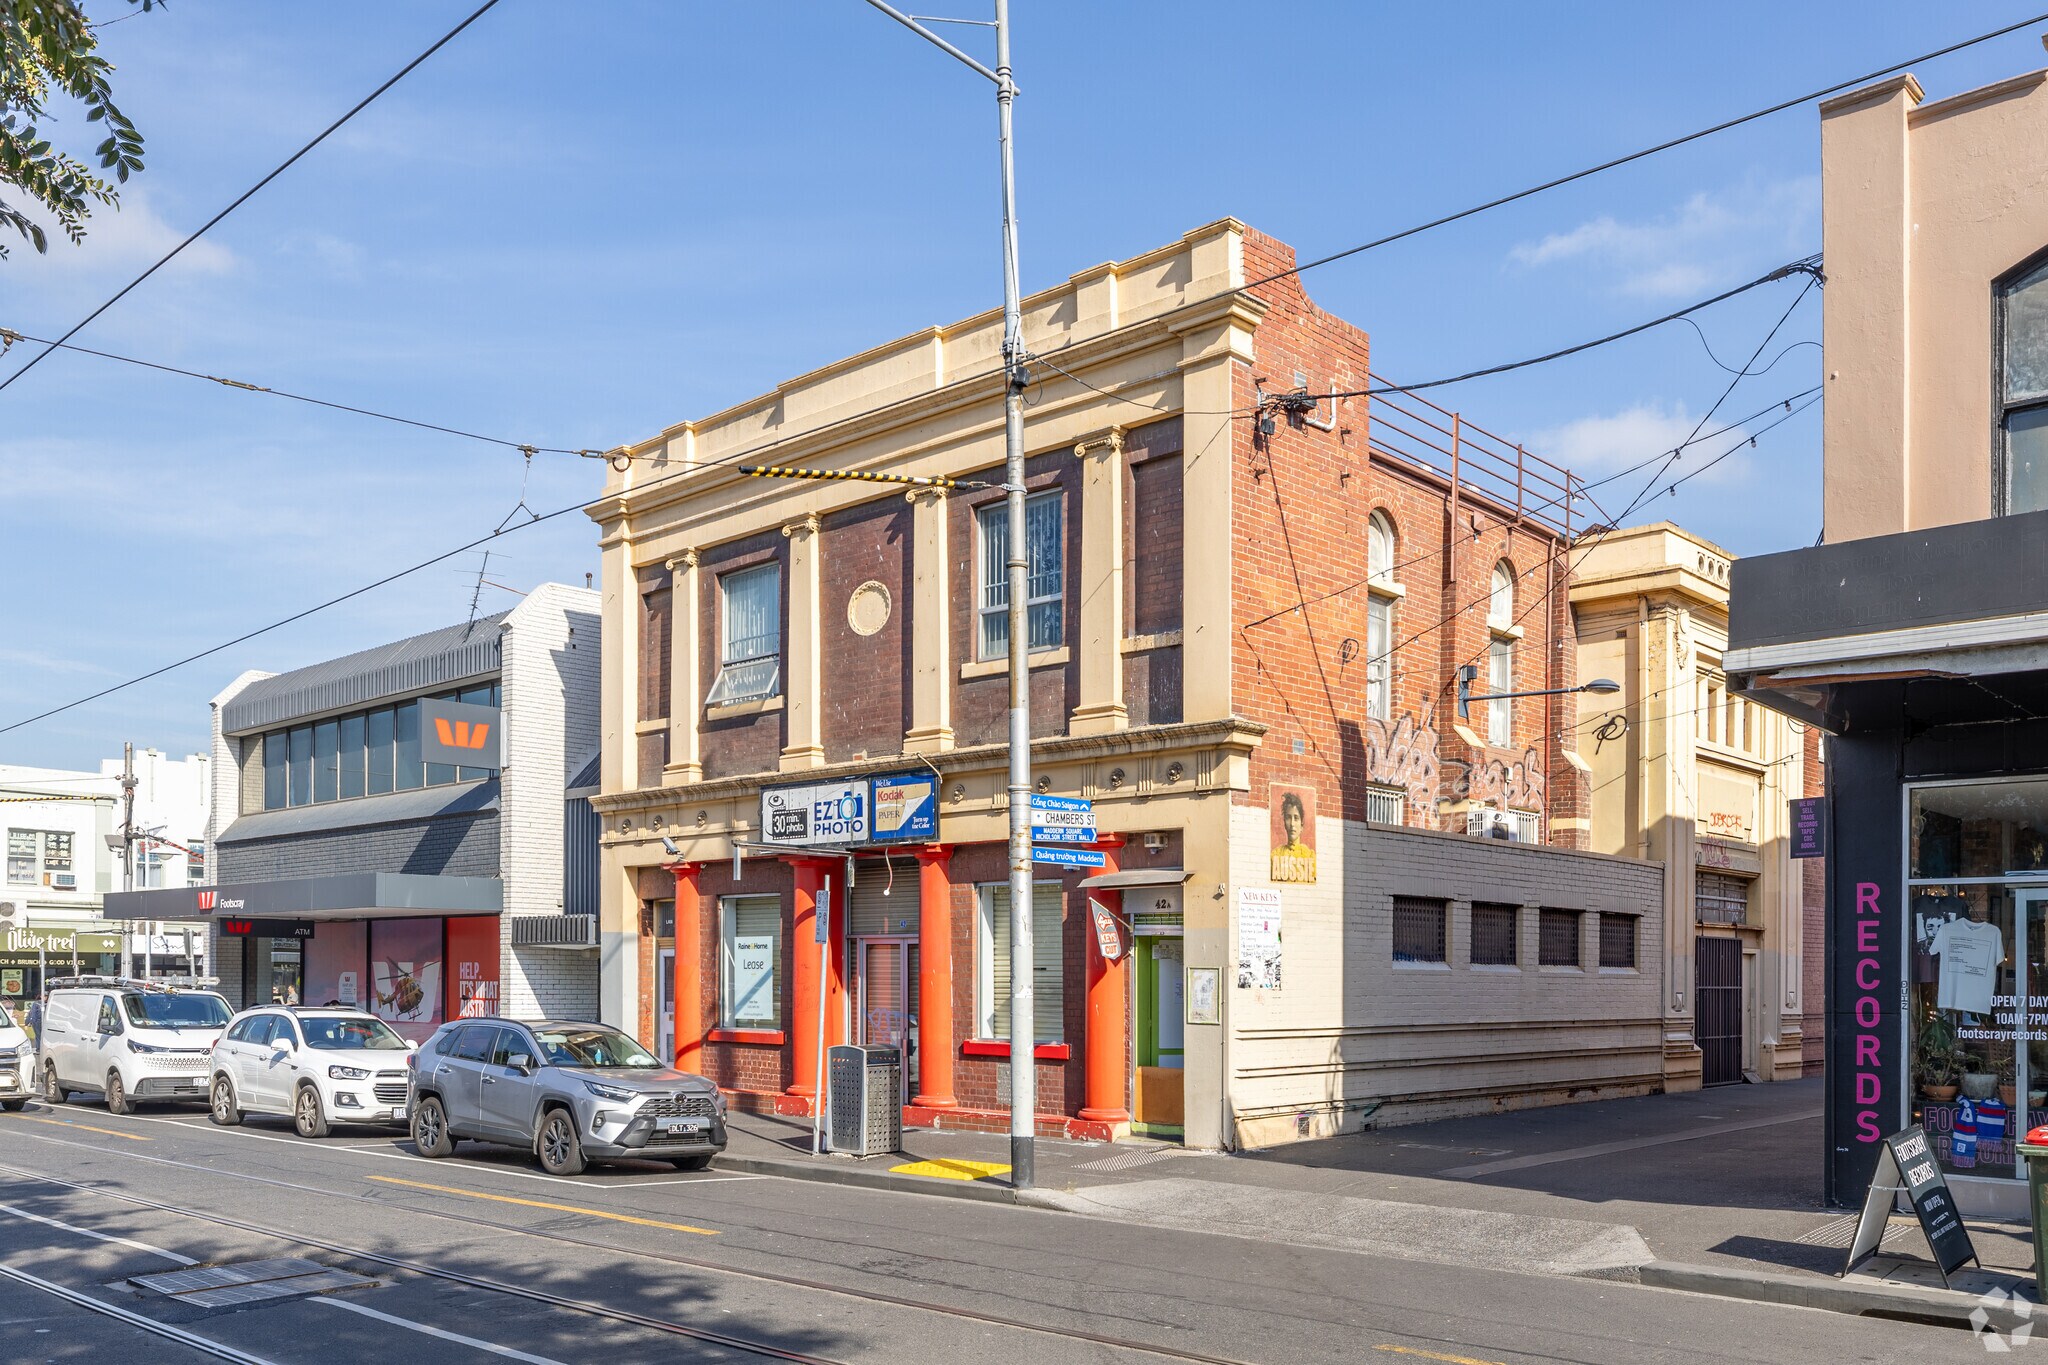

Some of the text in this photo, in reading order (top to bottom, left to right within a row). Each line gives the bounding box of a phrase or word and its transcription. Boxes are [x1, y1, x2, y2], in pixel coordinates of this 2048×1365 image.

[877, 789, 904, 802] Kodak
[1062, 801, 1079, 811] Saigon
[878, 810, 900, 820] PAPER
[1045, 812, 1095, 825] CHAMBERS ST
[773, 814, 786, 833] 30
[786, 821, 804, 833] photo
[814, 819, 863, 836] PHOTO
[1077, 854, 1104, 863] Maddern
[1271, 855, 1316, 883] AUSSIE
[1260, 892, 1277, 901] KEYS
[220, 898, 245, 909] Footscray
[1100, 933, 1117, 943] KEYS
[1104, 944, 1117, 954] CUT
[459, 962, 482, 979] HELP.
[743, 959, 764, 970] Lease
[459, 980, 499, 999] IT'S WHAT
[1990, 995, 2017, 1008] OPEN
[2020, 996, 2026, 1008] 7
[1855, 882, 1881, 1143] RECORDS
[1895, 1134, 1927, 1163] FOOTSCRAY
[1908, 1161, 1935, 1187] RECORDS
